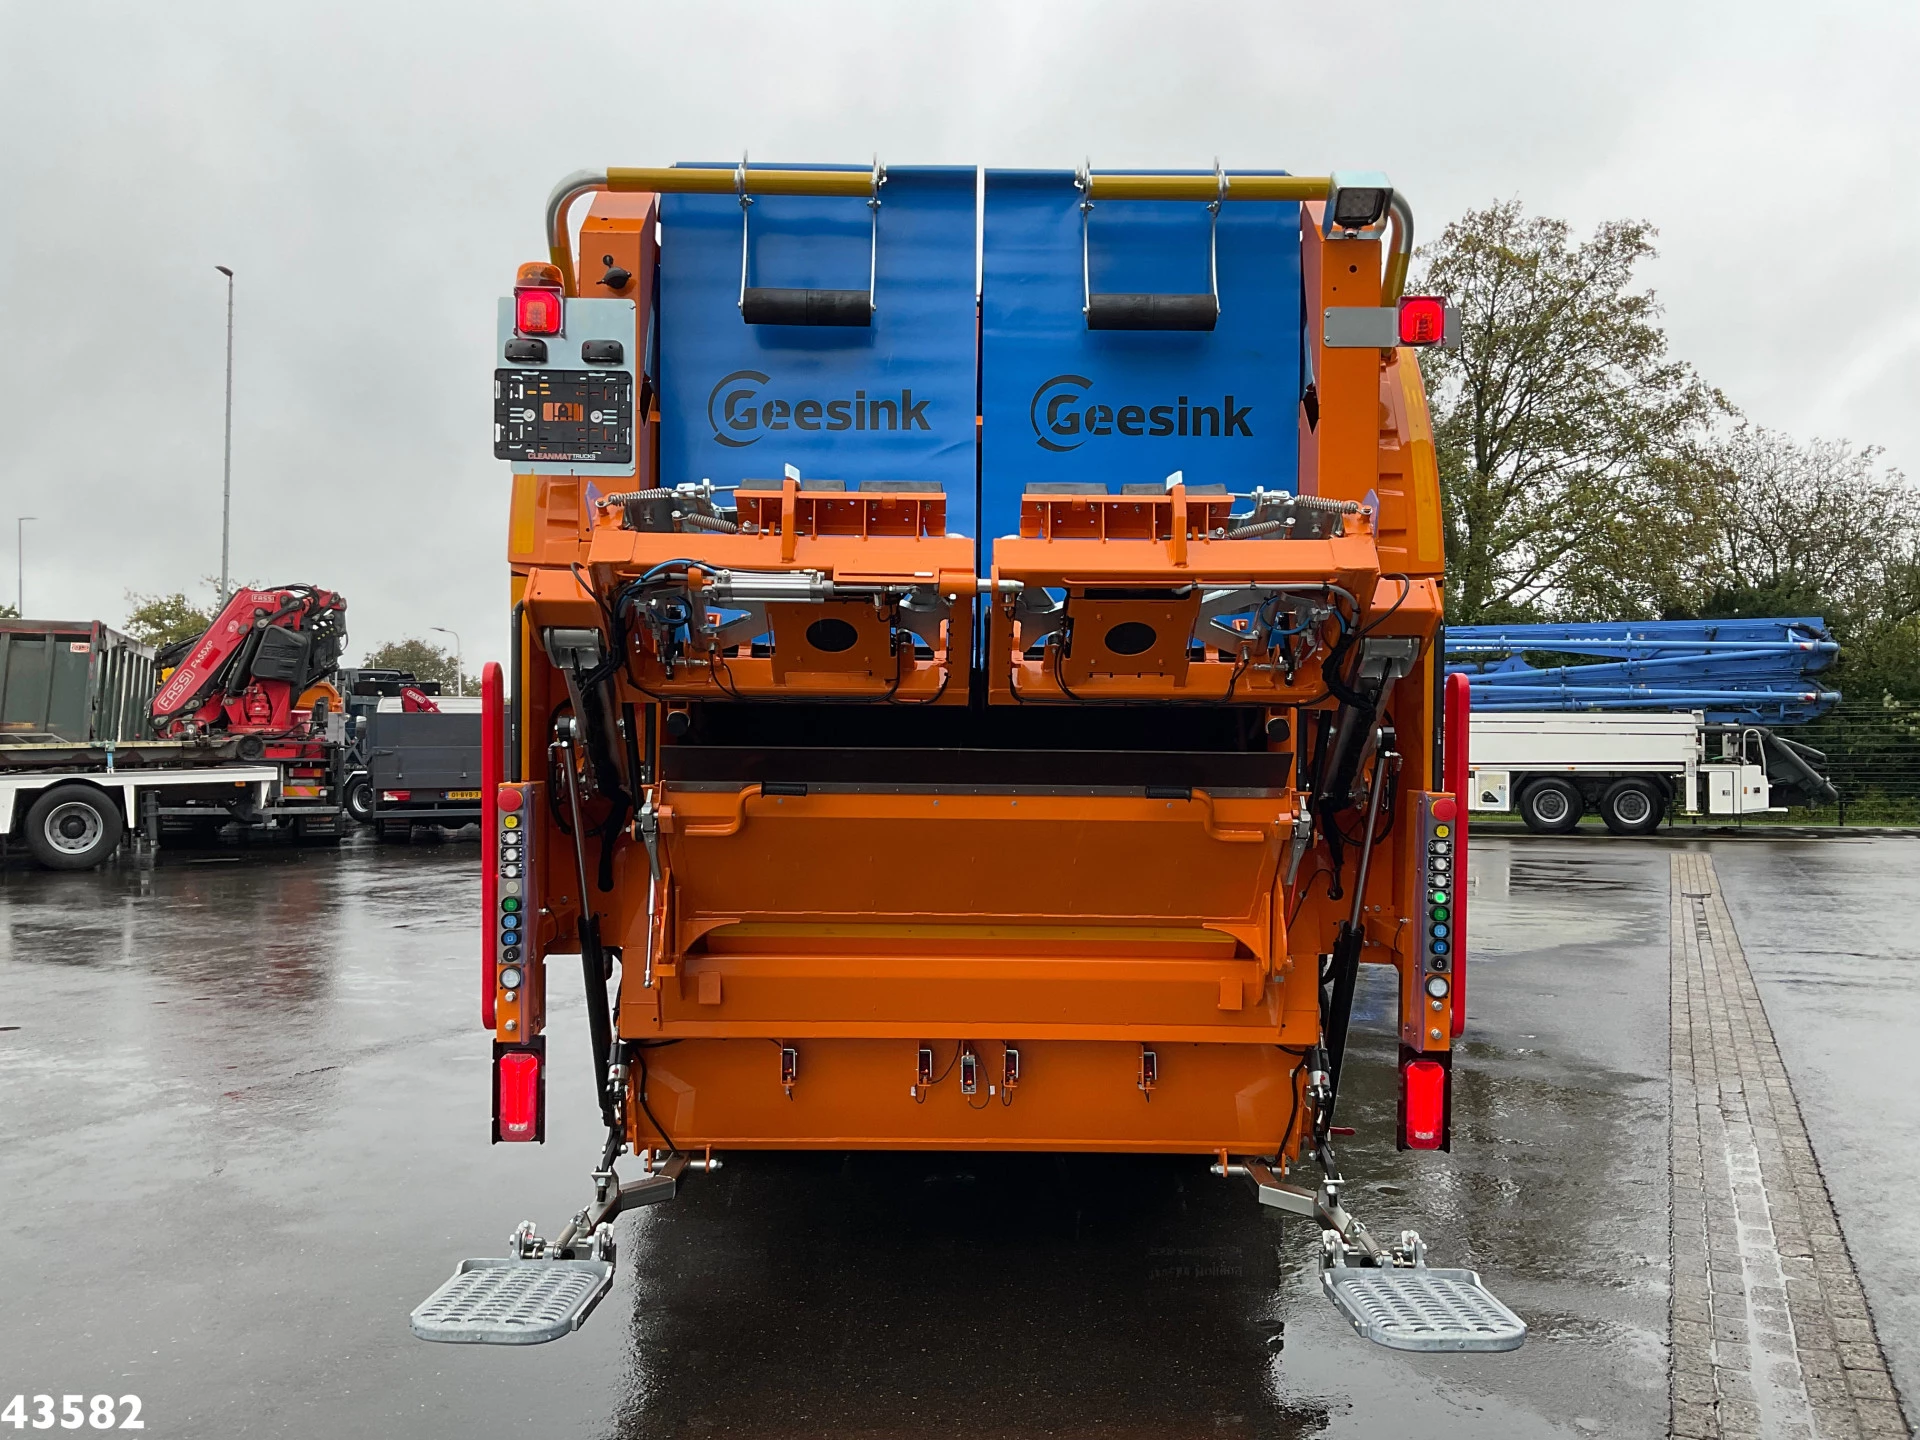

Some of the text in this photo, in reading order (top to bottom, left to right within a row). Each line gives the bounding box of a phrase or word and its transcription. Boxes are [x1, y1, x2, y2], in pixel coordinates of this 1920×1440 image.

[723, 387, 932, 432] Geesink
[1045, 393, 1254, 438] Geesink
[160, 671, 193, 708] FASSI
